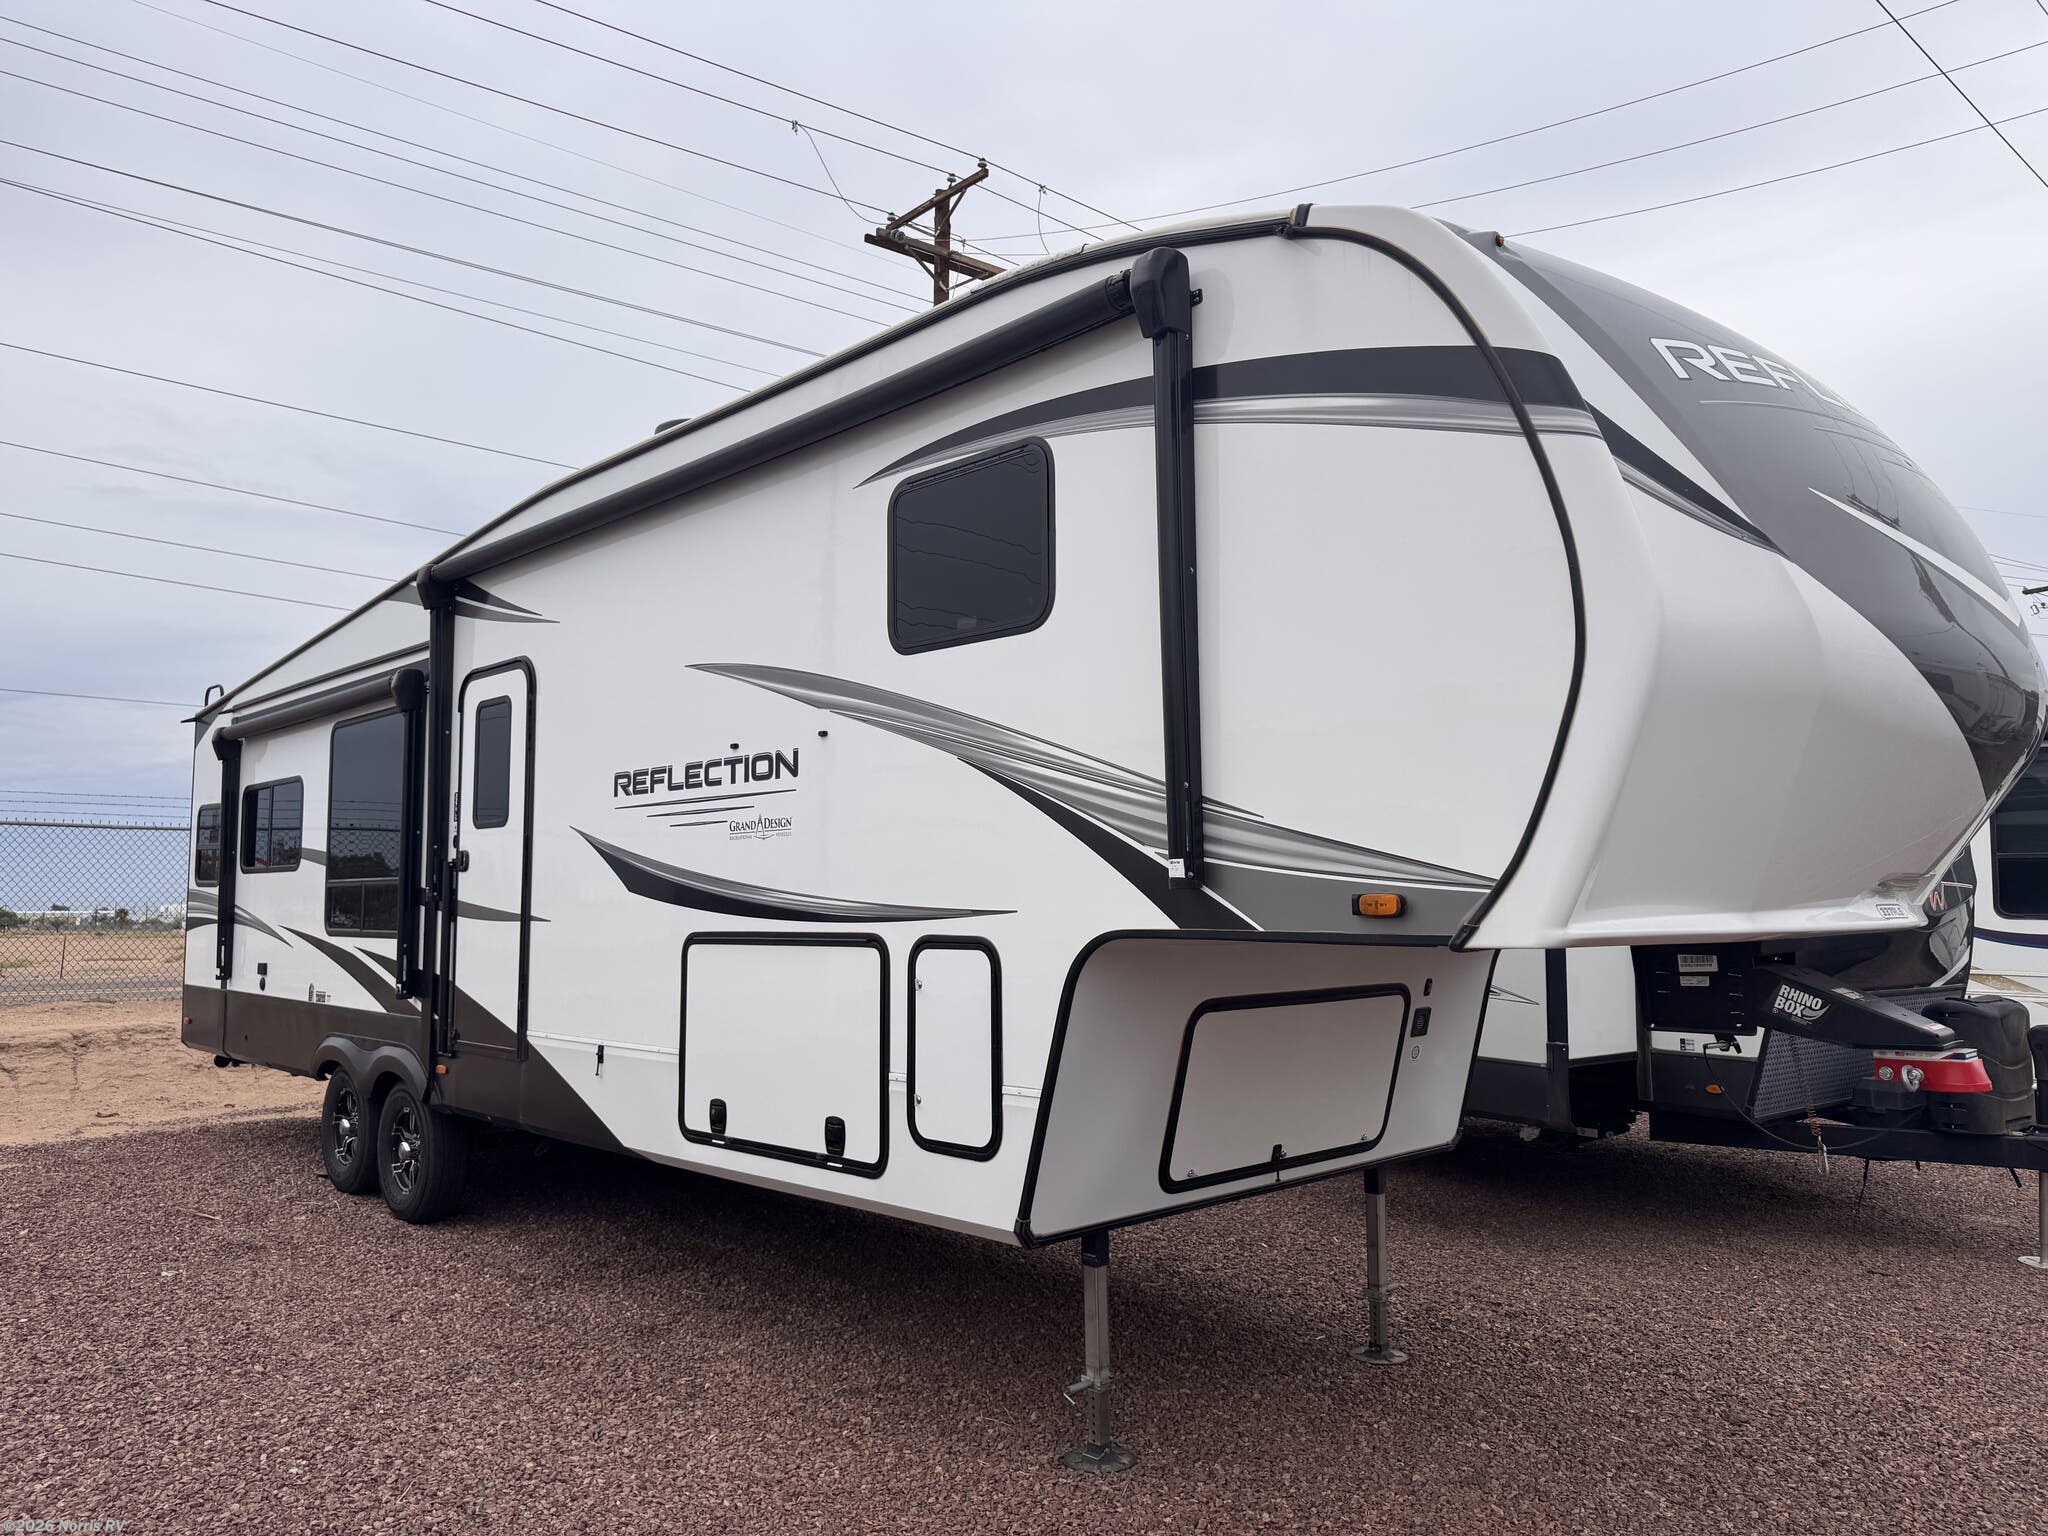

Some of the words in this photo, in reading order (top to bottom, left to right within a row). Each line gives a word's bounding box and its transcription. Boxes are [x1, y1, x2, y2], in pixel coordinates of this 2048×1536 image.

[613, 747, 799, 797] REFLECTION
[729, 820, 757, 832] GRAND
[764, 816, 792, 829] DESIGN
[1774, 995, 1806, 1018] BOX
[1779, 984, 1823, 1010] RHINO
